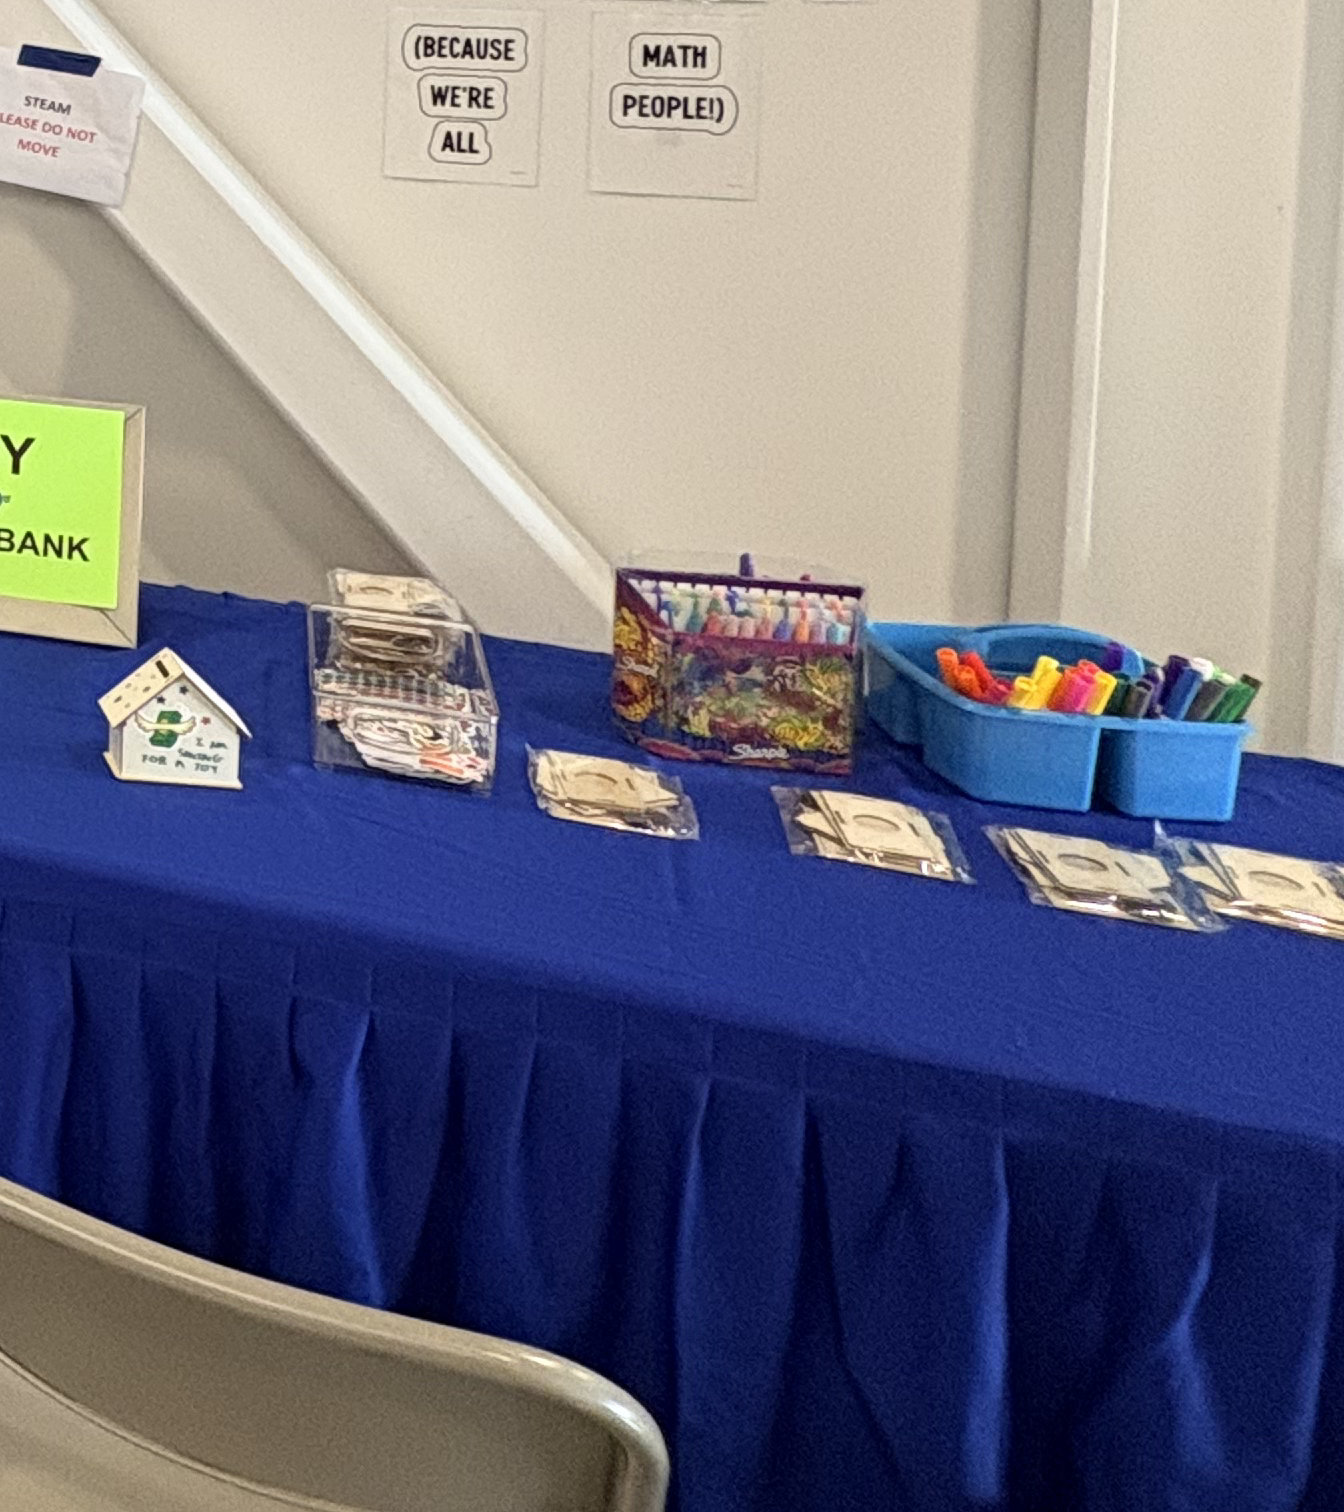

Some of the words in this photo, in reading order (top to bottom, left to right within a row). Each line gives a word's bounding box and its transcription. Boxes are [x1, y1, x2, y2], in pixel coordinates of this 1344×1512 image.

[414, 34, 516, 63] (BECAUSE
[641, 43, 707, 70] MATH
[23, 95, 72, 115] STEAM
[429, 83, 495, 111] WE'RE
[621, 93, 724, 123] PEOPLE!)
[42, 121, 63, 135] DO
[66, 127, 97, 143] NOT
[441, 129, 480, 154] ALL
[17, 139, 61, 157] MOVE
[728, 743, 790, 760] Sharpie
